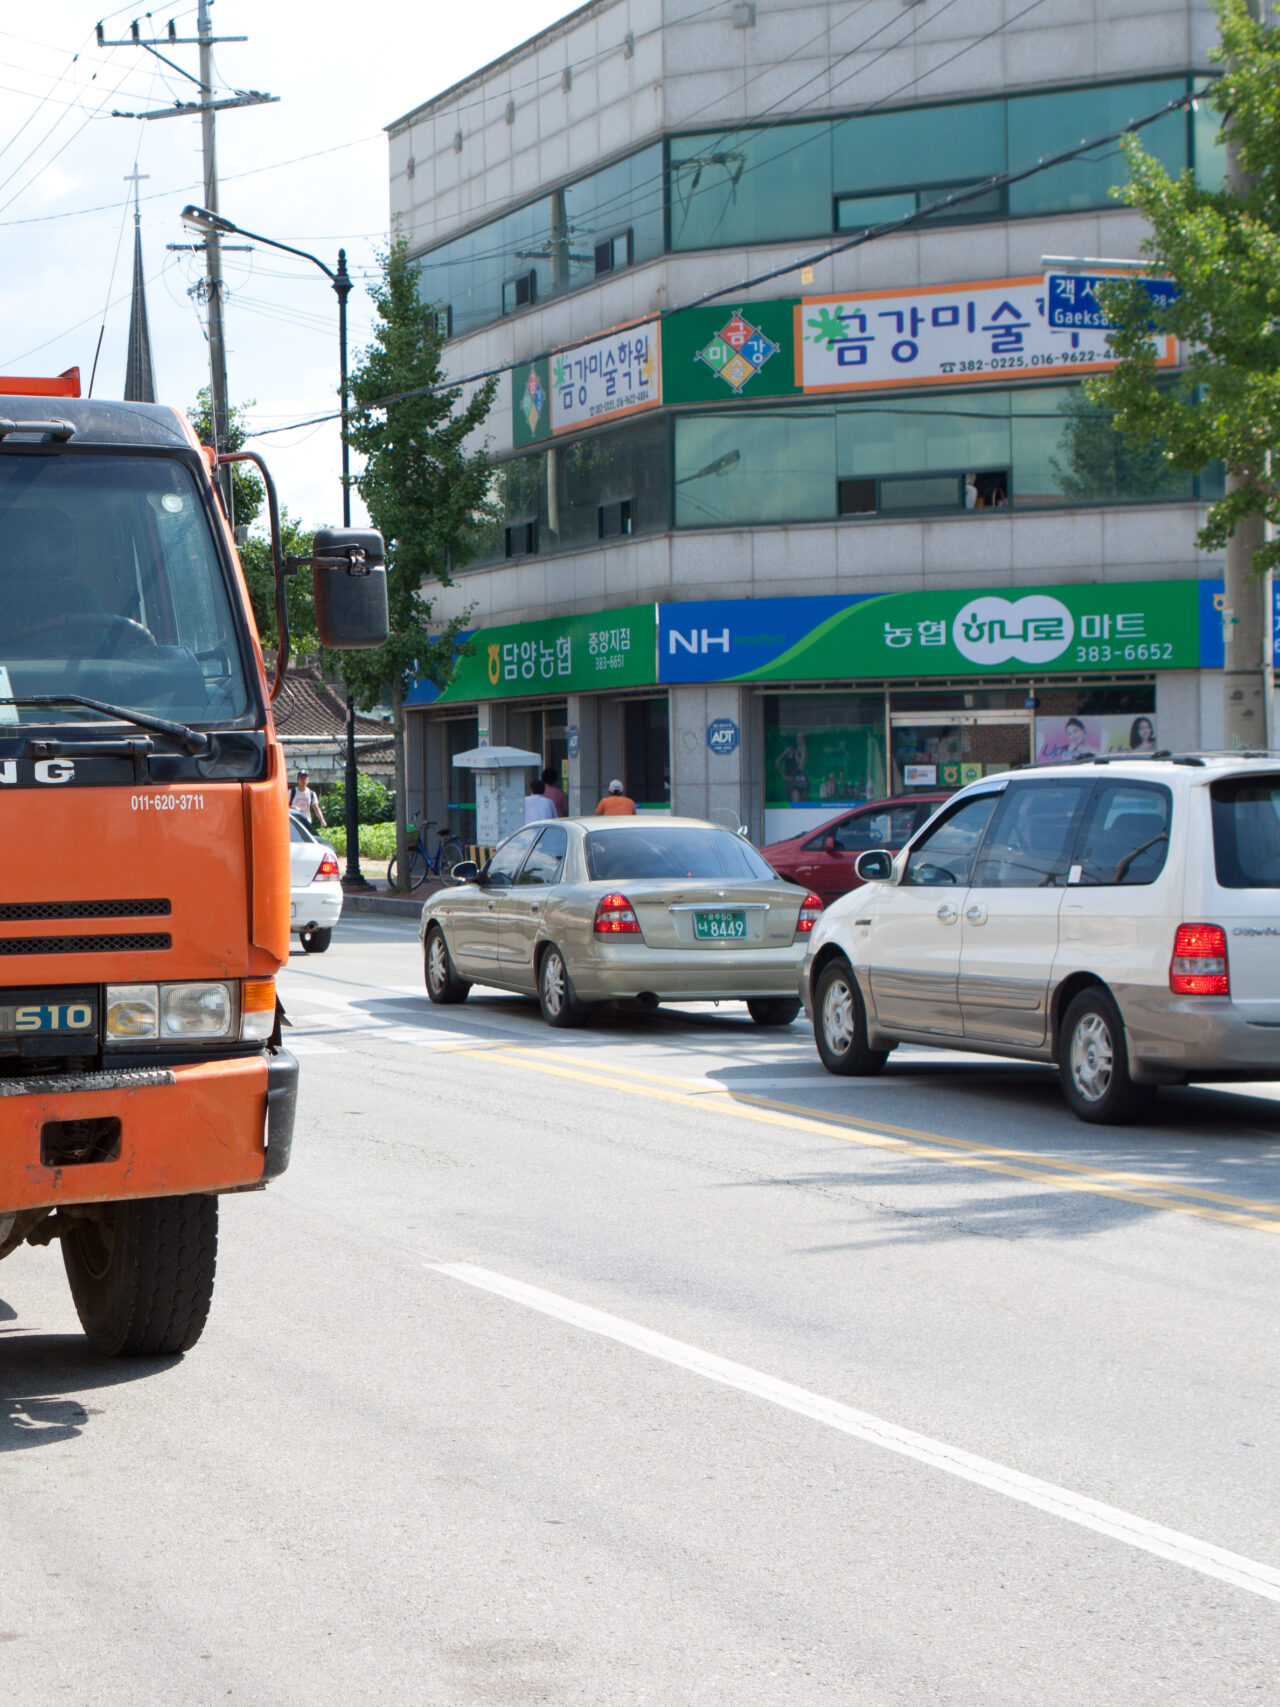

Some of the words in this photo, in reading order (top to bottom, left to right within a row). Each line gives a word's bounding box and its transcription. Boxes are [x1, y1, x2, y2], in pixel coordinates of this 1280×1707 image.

[561, 335, 649, 410] 금강미술학원
[588, 628, 631, 655] 중앙지점
[669, 628, 730, 654] NH
[884, 620, 947, 648] 농협
[963, 612, 1065, 644] 하나로
[1081, 613, 1147, 640] 마트
[503, 636, 571, 680] 담양농협
[595, 655, 625, 671] 383-6651
[1076, 643, 1173, 663] 383-6652
[711, 730, 735, 744] ADT
[130, 795, 205, 811] 011-620-3711
